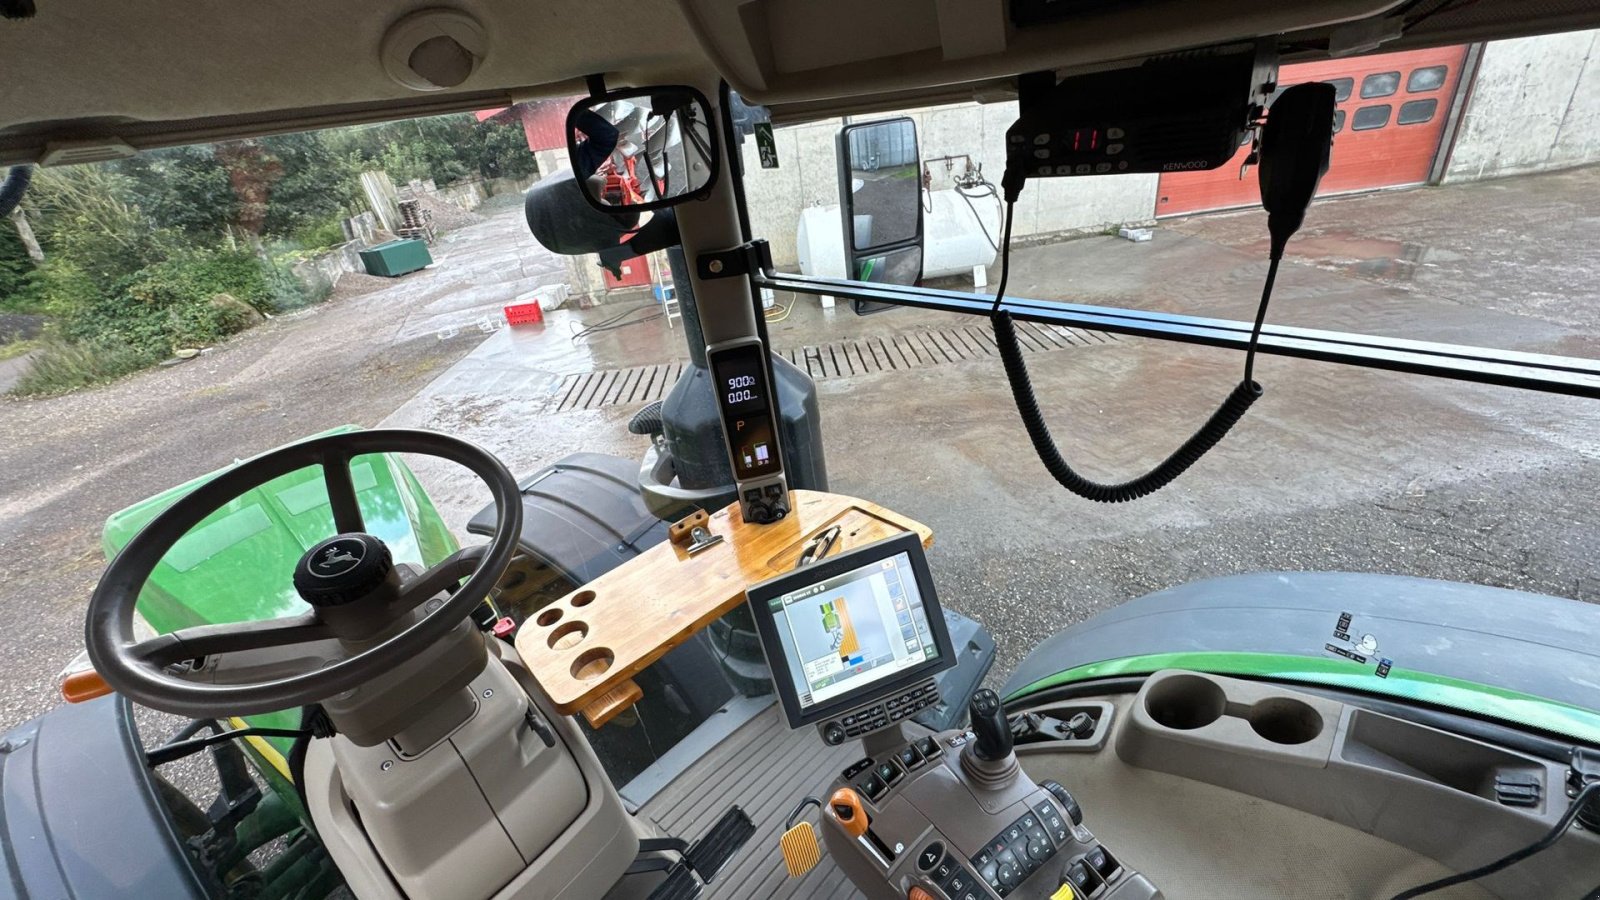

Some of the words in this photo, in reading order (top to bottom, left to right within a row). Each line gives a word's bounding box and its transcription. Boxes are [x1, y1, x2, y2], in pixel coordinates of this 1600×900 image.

[1163, 160, 1208, 171] KENWOOD
[728, 376, 749, 389] 900
[728, 390, 750, 403] 0.00
[736, 420, 745, 431] P
